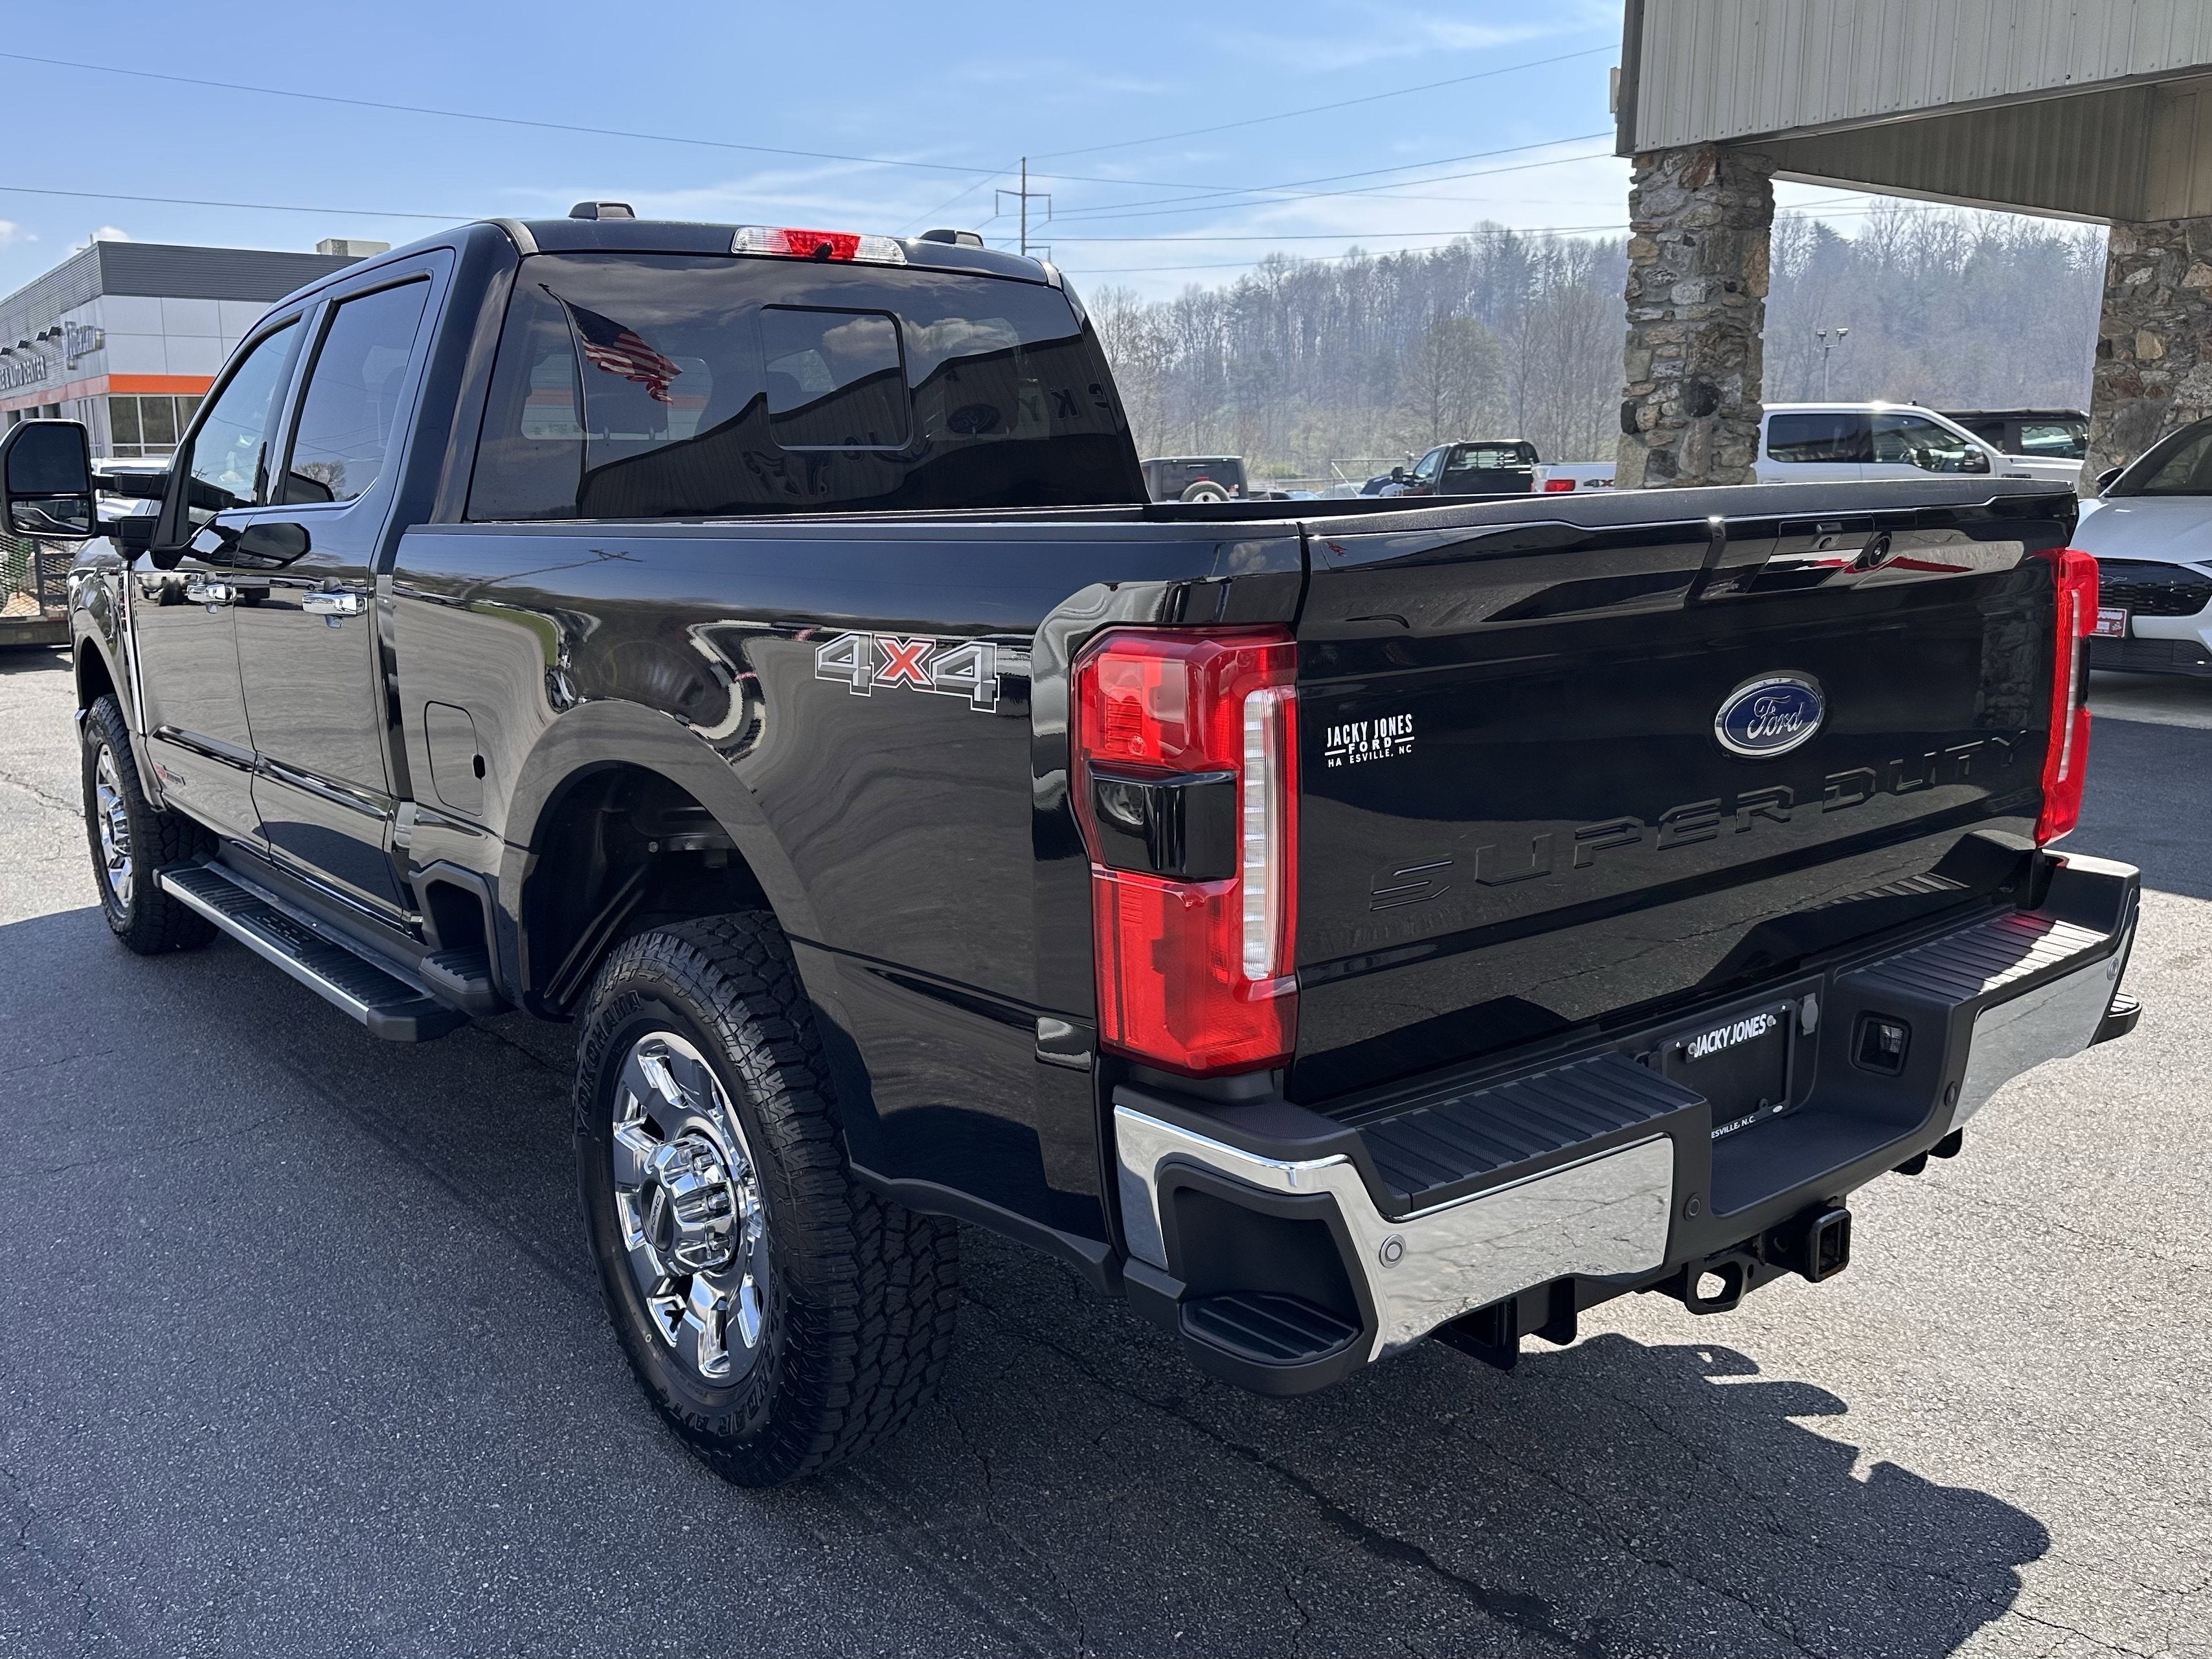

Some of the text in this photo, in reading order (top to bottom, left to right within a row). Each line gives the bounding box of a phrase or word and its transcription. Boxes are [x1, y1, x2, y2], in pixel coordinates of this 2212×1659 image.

[1583, 479, 1614, 488] 4X
[1327, 714, 1413, 747] JACKY JONES
[1746, 695, 1805, 739] Ford
[1348, 737, 1392, 754] FORD
[1399, 745, 1412, 754] NC
[1370, 730, 2027, 911] SUPER DUTY
[1694, 1013, 1766, 1058] JACKY JONES
[577, 989, 644, 1136] YOKOHAMA
[1741, 1115, 1756, 1127] N.C.
